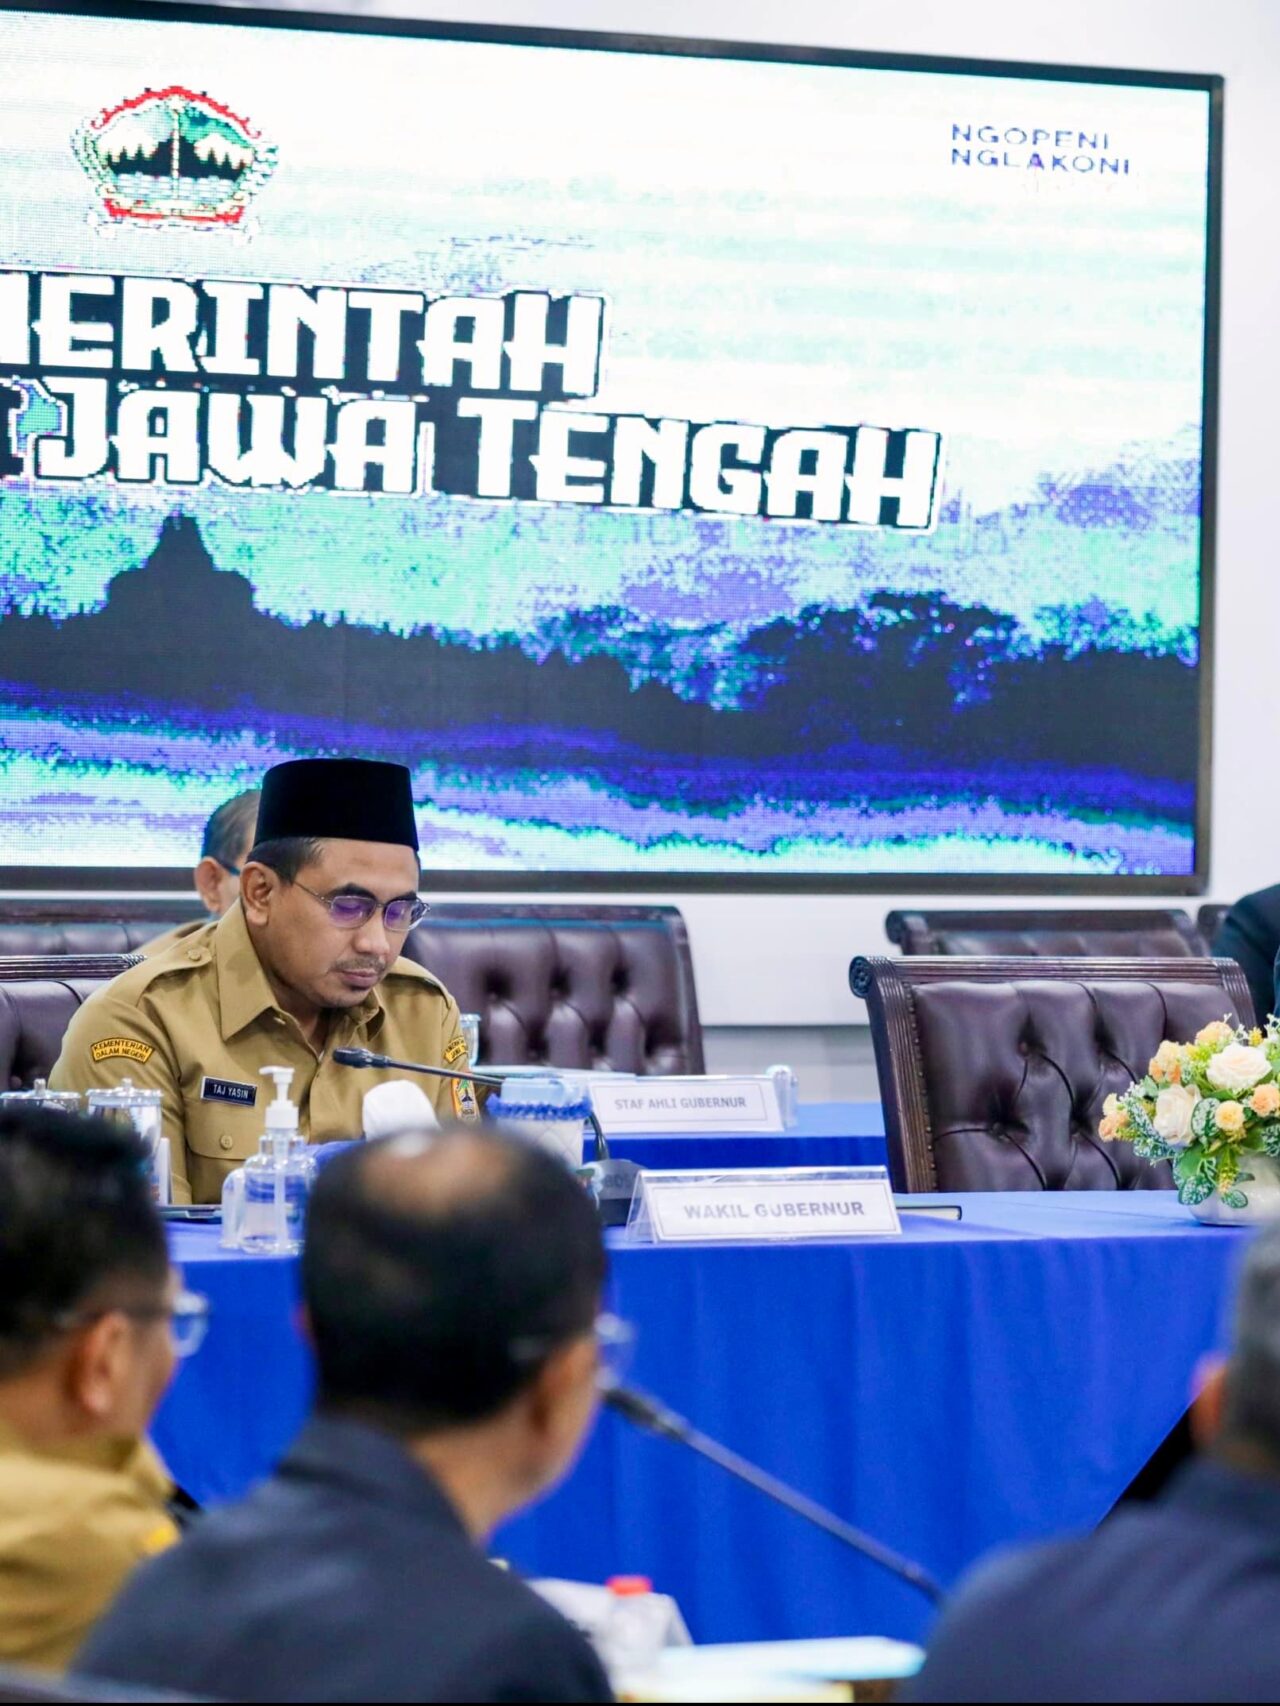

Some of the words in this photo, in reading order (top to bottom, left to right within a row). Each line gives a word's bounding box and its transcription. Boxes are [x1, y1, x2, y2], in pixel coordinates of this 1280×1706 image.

[952, 123, 1108, 150] NGOPENI
[951, 147, 1130, 175] NGLAKONI
[0, 271, 598, 394] ERINTAH
[38, 376, 416, 493] JAWA
[456, 397, 942, 528] TENGAH
[94, 1040, 149, 1053] KEMENTERIAN
[96, 1047, 120, 1059] DALAM
[122, 1048, 147, 1060] NEGERI
[213, 1083, 226, 1096] TAJ
[228, 1087, 249, 1100] YASIN
[614, 1098, 645, 1110] STAF
[648, 1098, 677, 1109] AHLI
[680, 1096, 747, 1109] GUBERNUR
[684, 1202, 749, 1220] WAKIL
[754, 1201, 865, 1218] GUBERNUR
